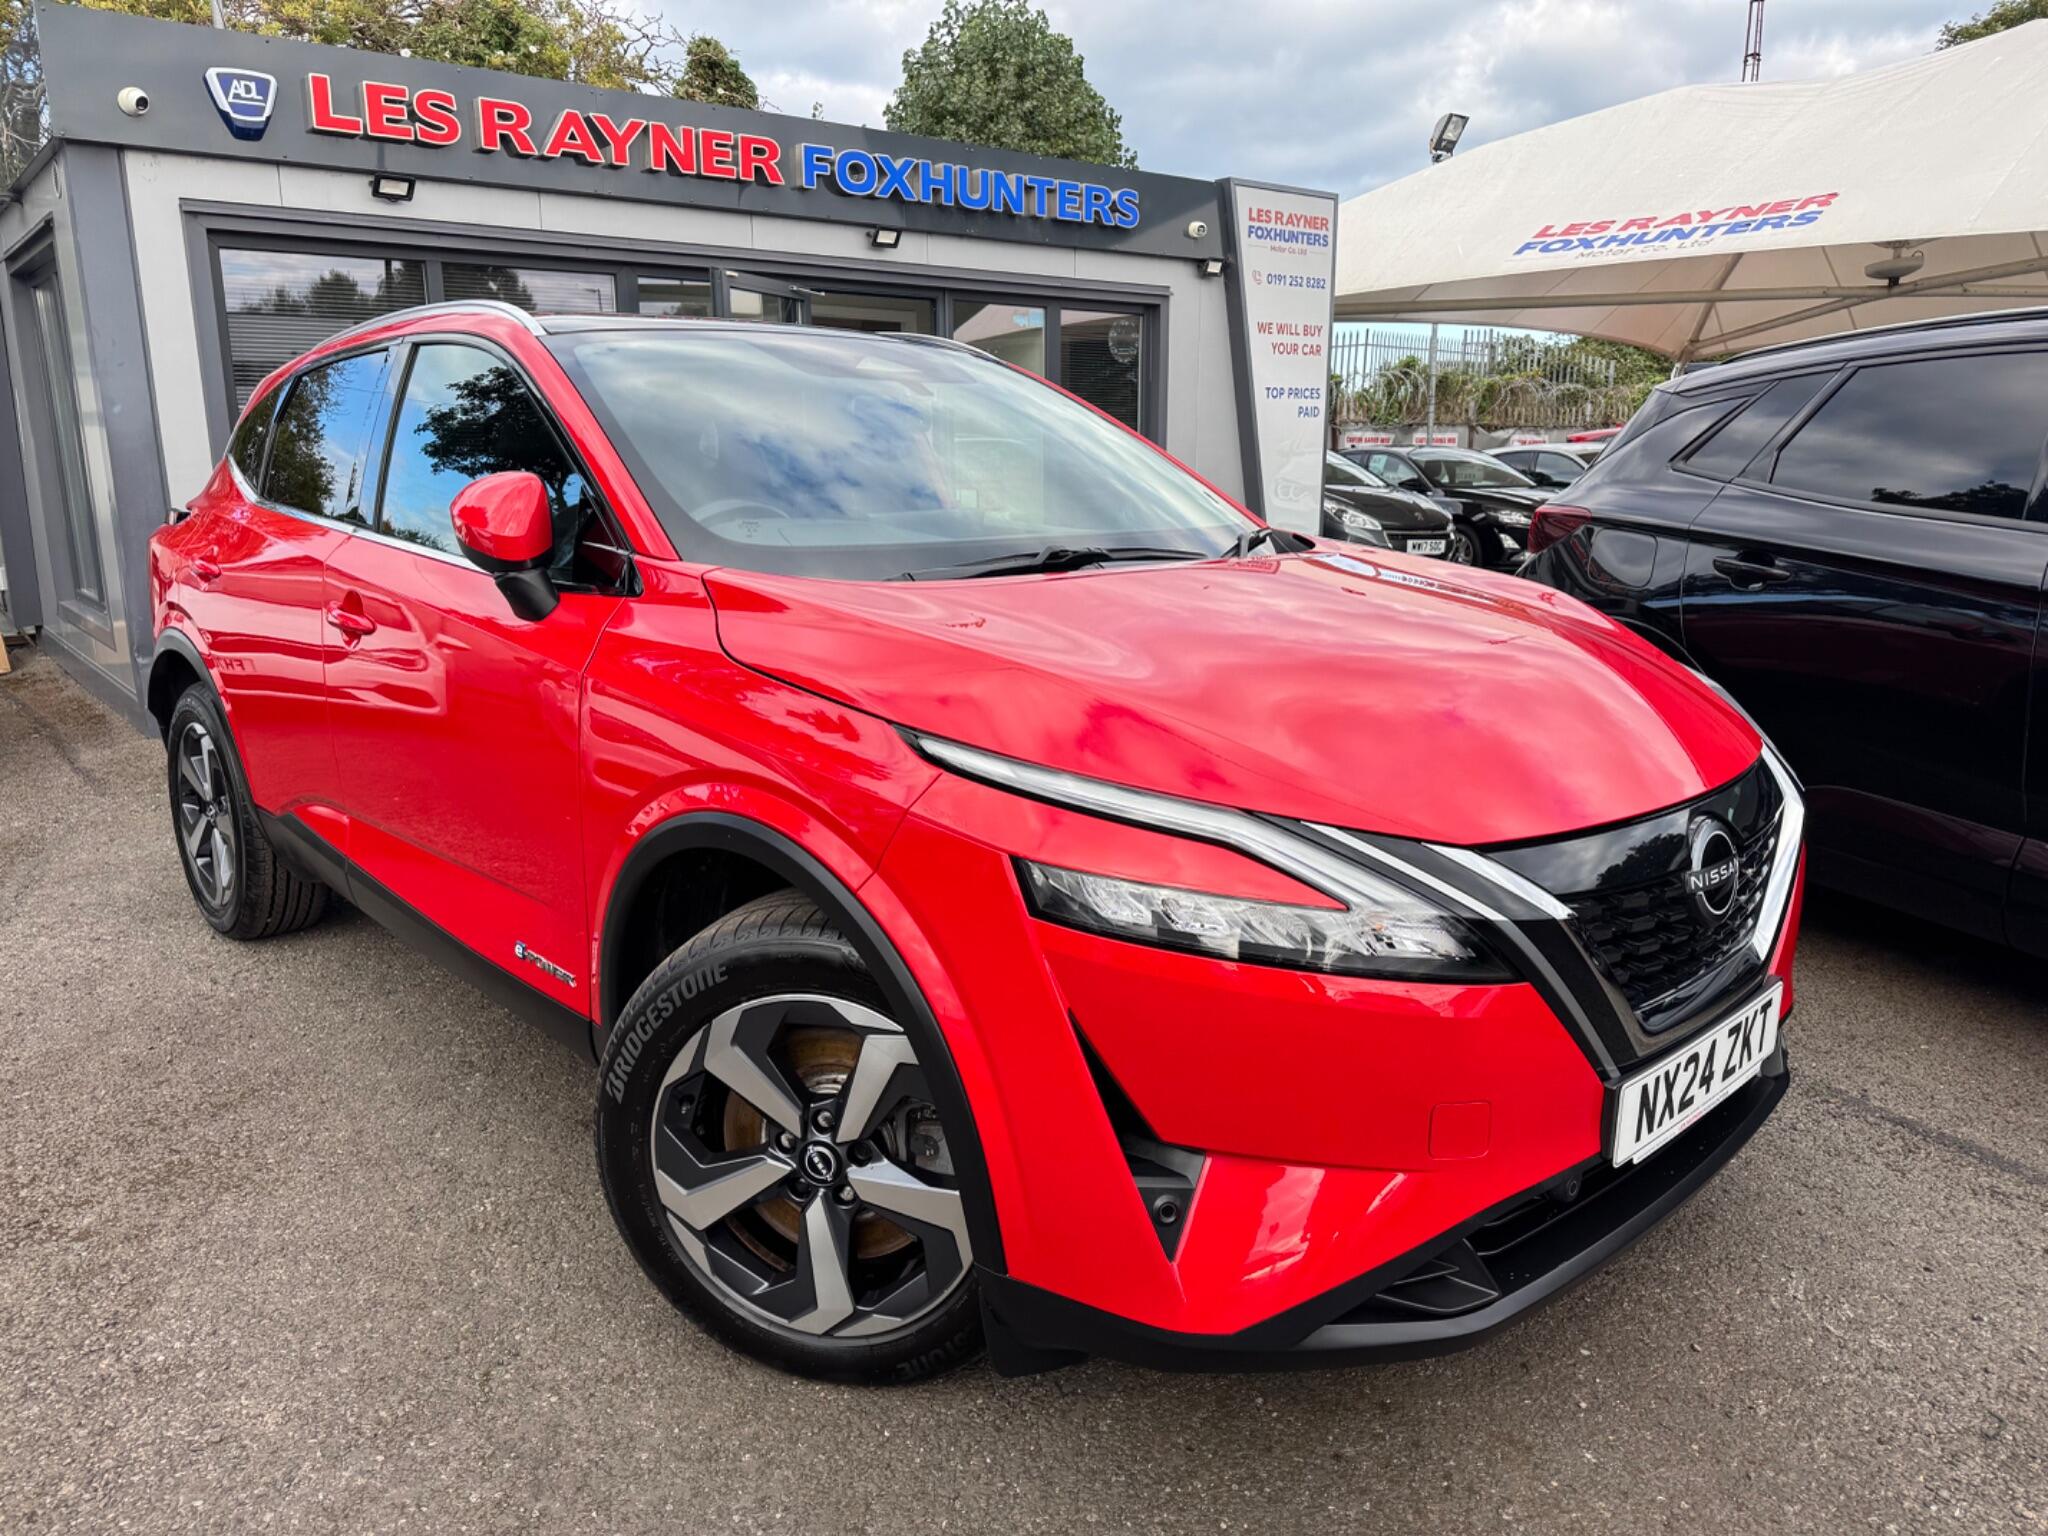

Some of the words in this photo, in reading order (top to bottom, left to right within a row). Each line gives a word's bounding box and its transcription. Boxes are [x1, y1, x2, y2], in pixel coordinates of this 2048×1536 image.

[228, 78, 264, 102] ADL
[307, 72, 462, 147] LES
[477, 96, 785, 186] RAYNER
[801, 143, 1141, 229] FOXHUNTERS
[1248, 206, 1272, 224] LES
[1274, 210, 1329, 232] RAYNER
[1532, 219, 1617, 239] LES
[1618, 191, 1840, 232] RAYNER
[1248, 225, 1329, 247] FOXHUNTERS
[1513, 210, 1824, 256] FOXHUNTERS
[1575, 246, 1634, 260] Motor
[1677, 237, 1714, 249] Ltd
[1266, 273, 1286, 286] 0191
[1289, 275, 1304, 287] 252
[1306, 277, 1326, 289] 8282
[1257, 321, 1273, 335] WE
[1275, 322, 1300, 337] WILL
[1303, 324, 1323, 338] BUY
[1271, 342, 1299, 356] YOUR
[1302, 343, 1322, 357] CAR
[1265, 387, 1285, 400] TOP
[1287, 387, 1320, 401] PRICES
[1297, 405, 1320, 418] PAID
[605, 961, 729, 1105] BRIDGESTONE
[1634, 1039, 1718, 1144] NX24
[1721, 998, 1774, 1083] ZKT
